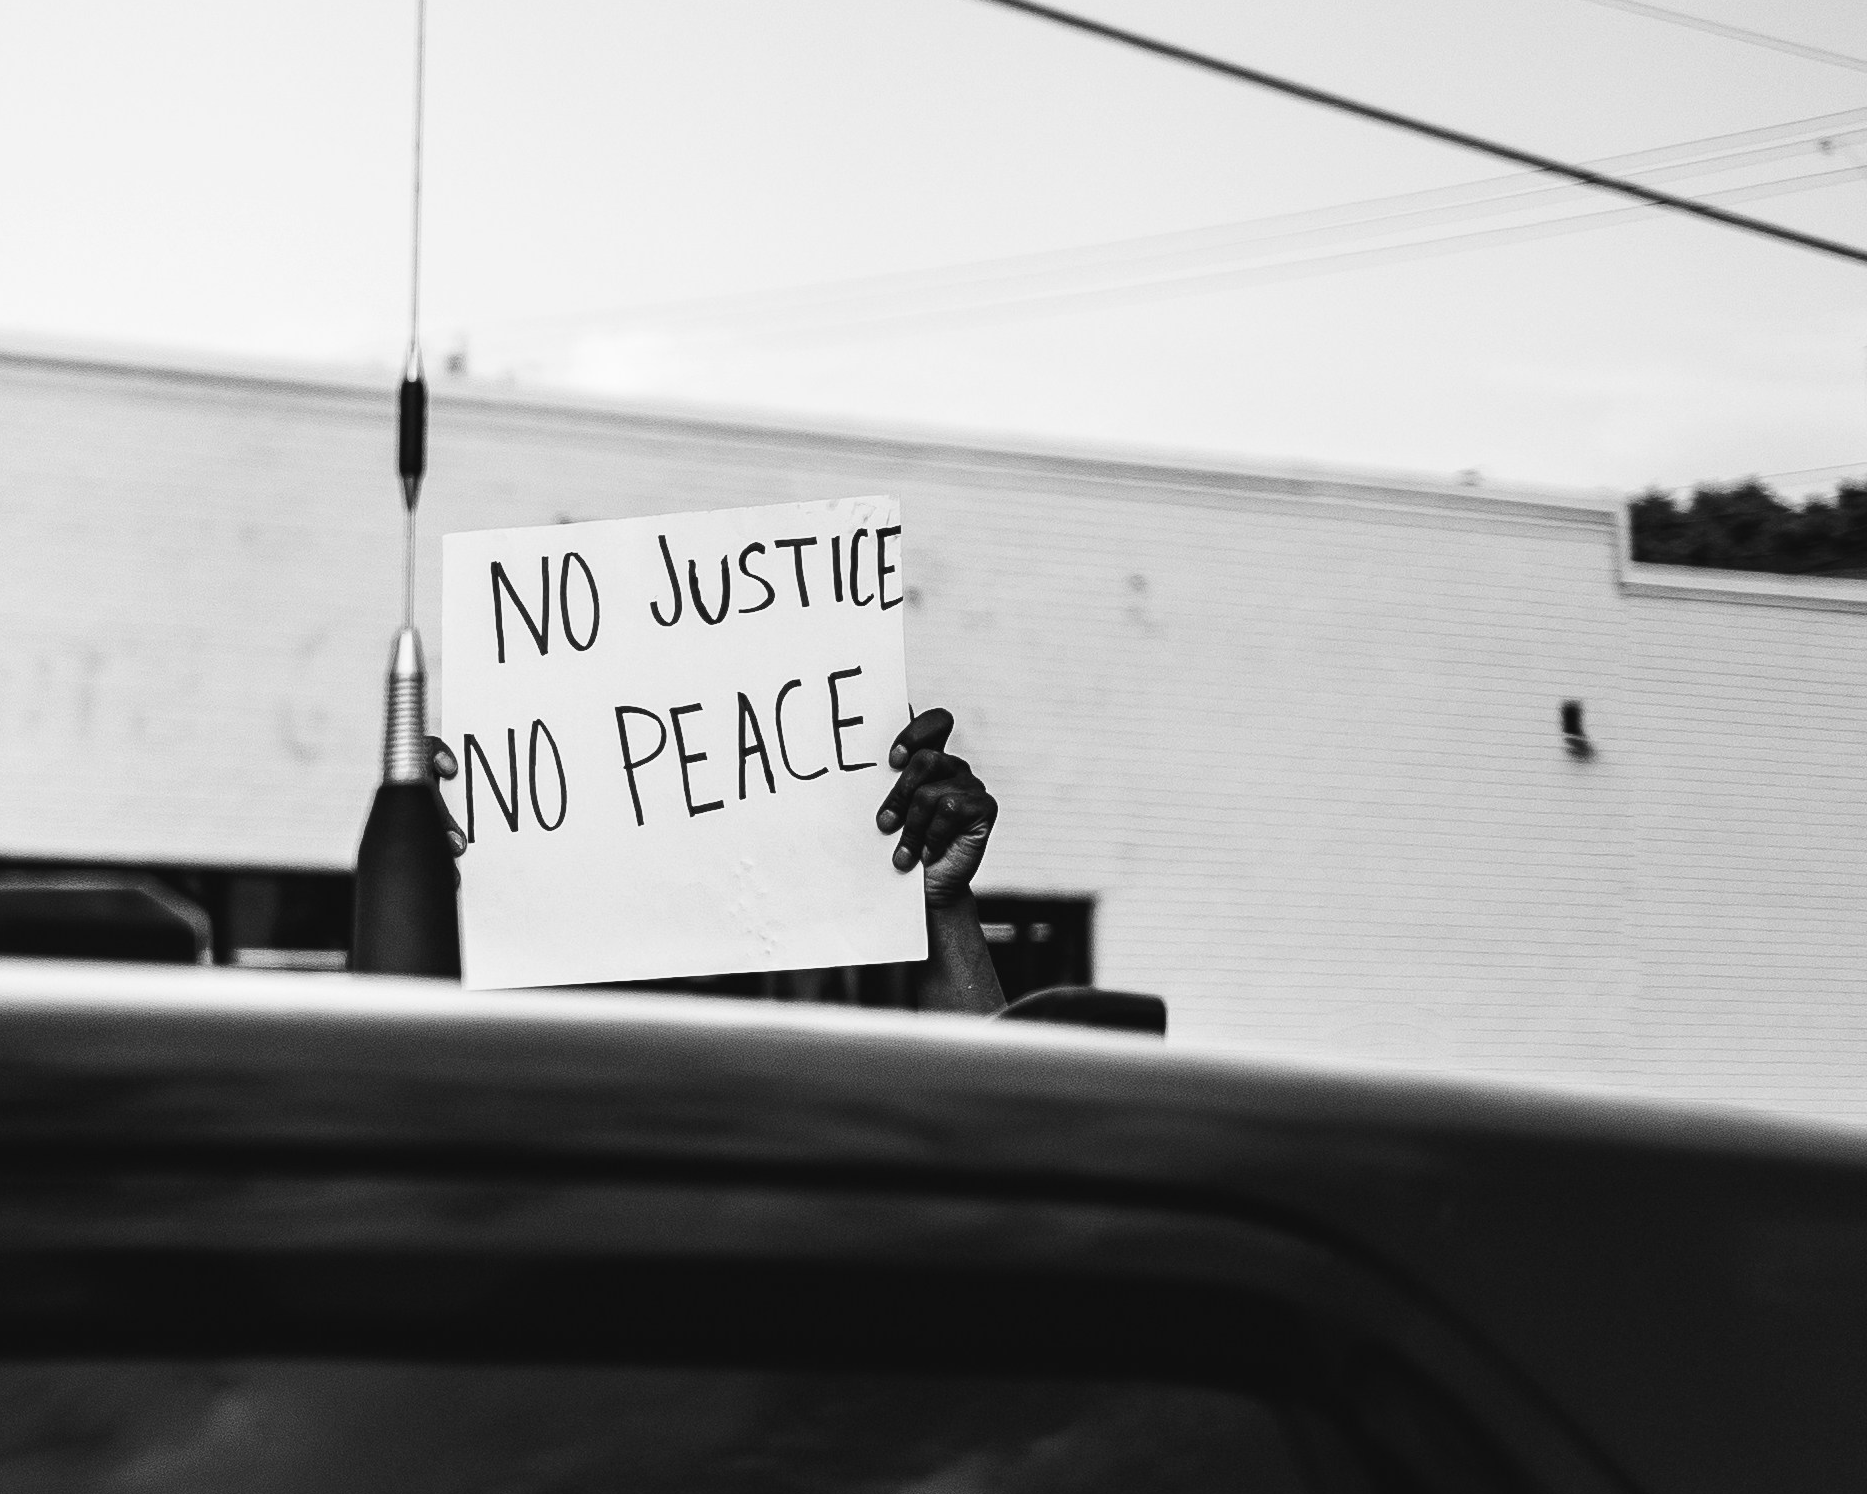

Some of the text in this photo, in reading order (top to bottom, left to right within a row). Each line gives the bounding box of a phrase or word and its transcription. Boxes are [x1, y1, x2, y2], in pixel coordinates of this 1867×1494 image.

[490, 525, 904, 664] NO JUSTICE
[464, 665, 878, 844] NO PEACE
